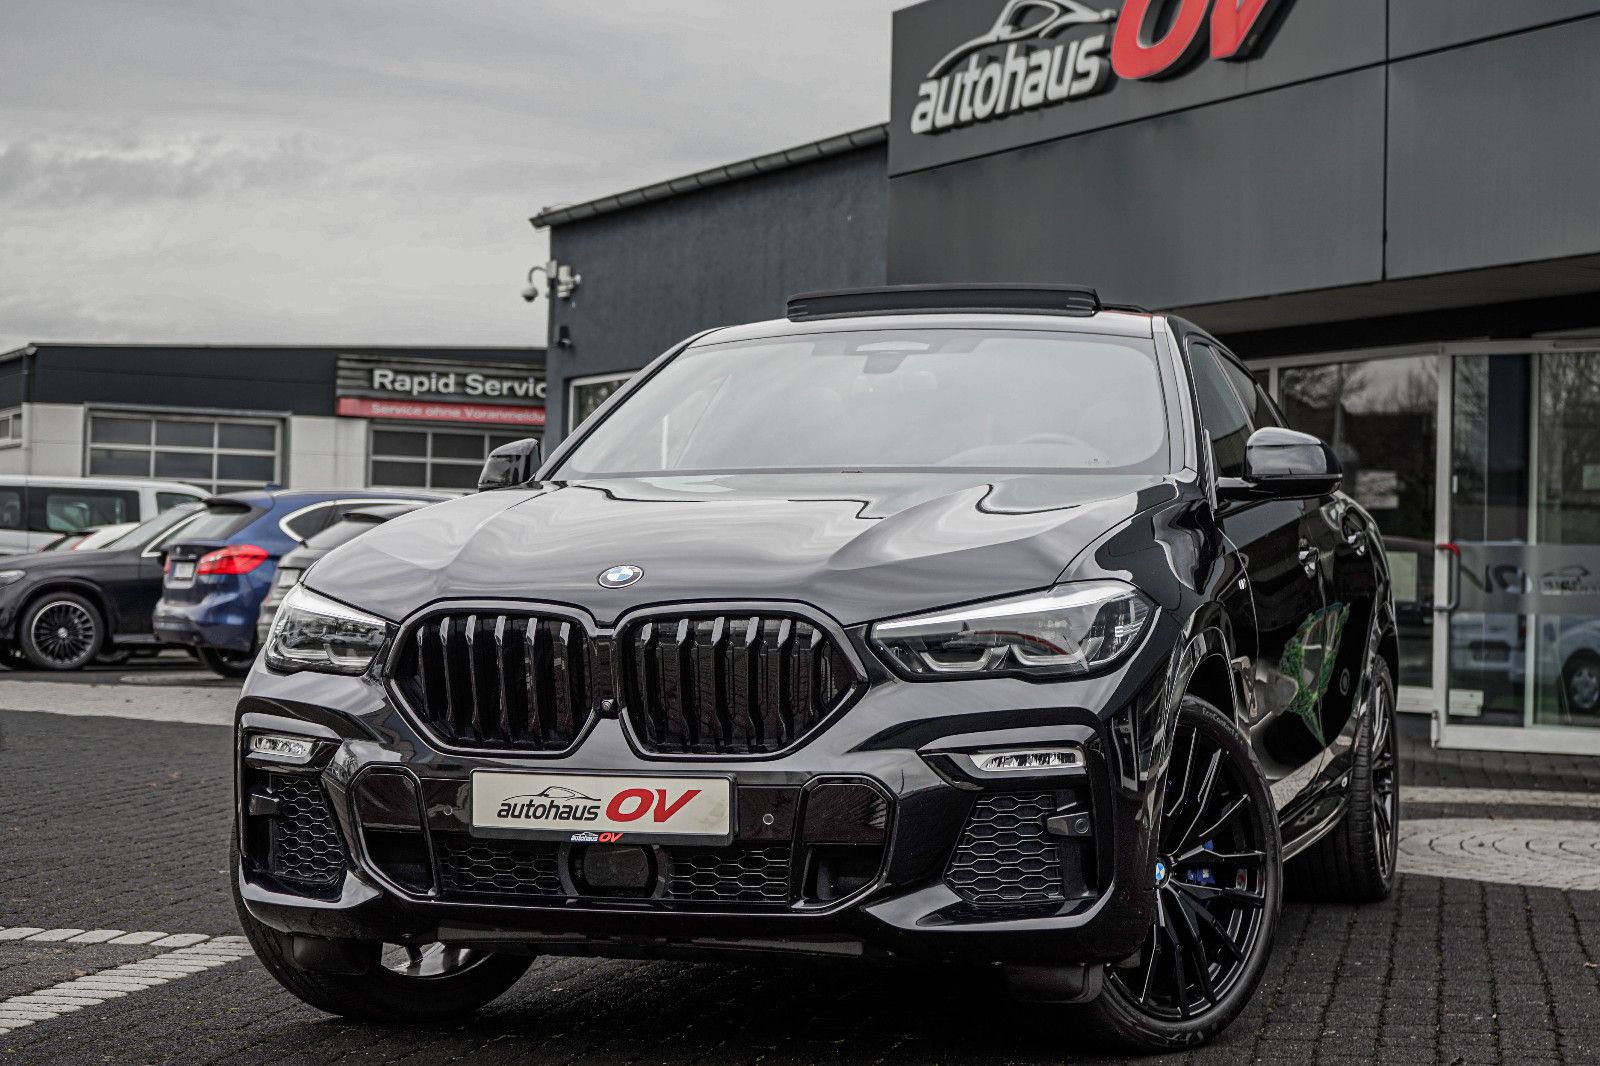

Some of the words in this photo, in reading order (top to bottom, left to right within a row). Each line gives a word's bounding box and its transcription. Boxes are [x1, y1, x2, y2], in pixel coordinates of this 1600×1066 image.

[911, 34, 1105, 134] autohaus
[373, 369, 456, 396] Rapid
[370, 403, 422, 417] Service
[497, 799, 601, 821] autohaus
[605, 788, 702, 822] OV
[598, 832, 624, 843] OV
